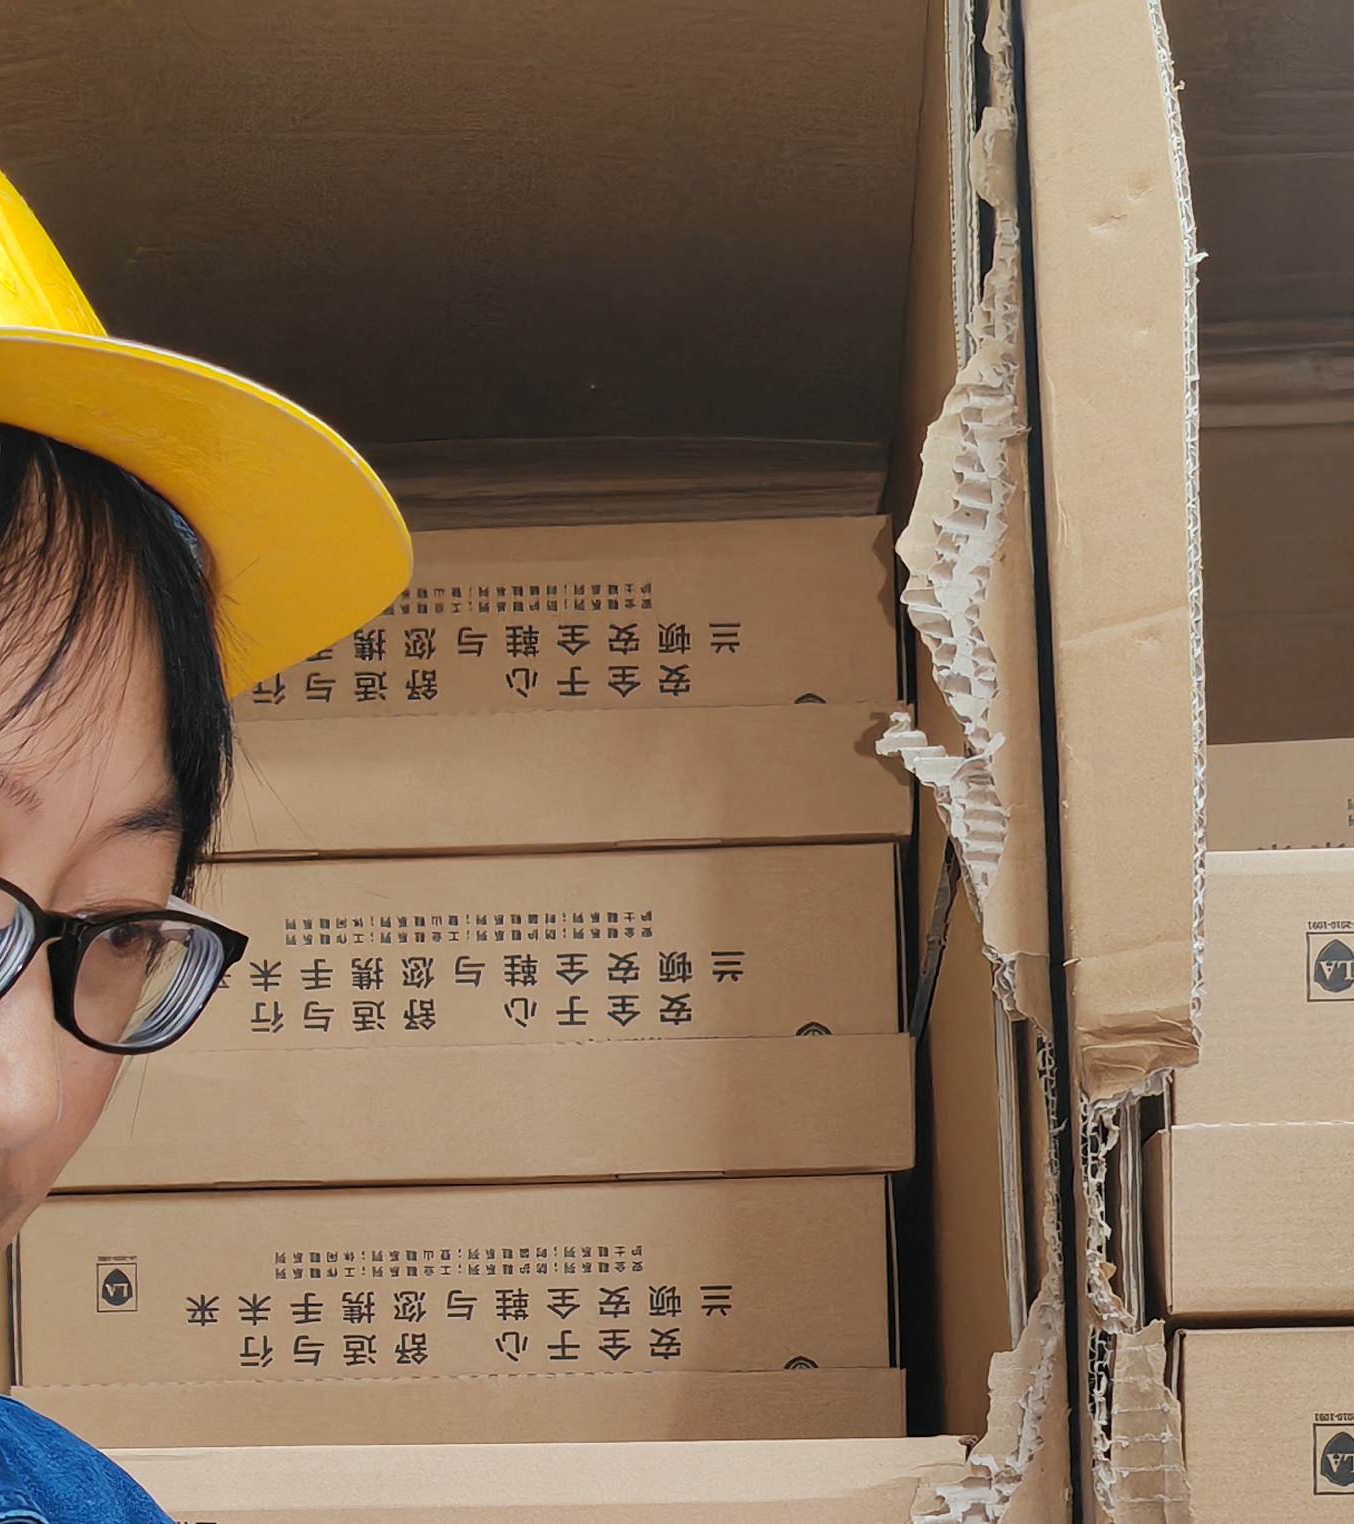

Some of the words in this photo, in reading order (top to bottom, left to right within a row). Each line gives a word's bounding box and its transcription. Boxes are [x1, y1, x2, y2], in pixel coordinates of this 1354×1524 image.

[253, 668, 438, 705] 舒适与行
[506, 664, 691, 701] 安全于心
[219, 951, 746, 992] 兰顿安全鞋与您携手未
[1319, 960, 1354, 981] LA
[251, 999, 436, 1033] 舒适与行
[505, 993, 692, 1027] 安全于心
[105, 1283, 129, 1298] LA
[186, 1284, 734, 1328] 兰顿安全鞋与您携手未来
[239, 1333, 429, 1369] 舒适与行
[495, 1329, 682, 1362] 安全于心
